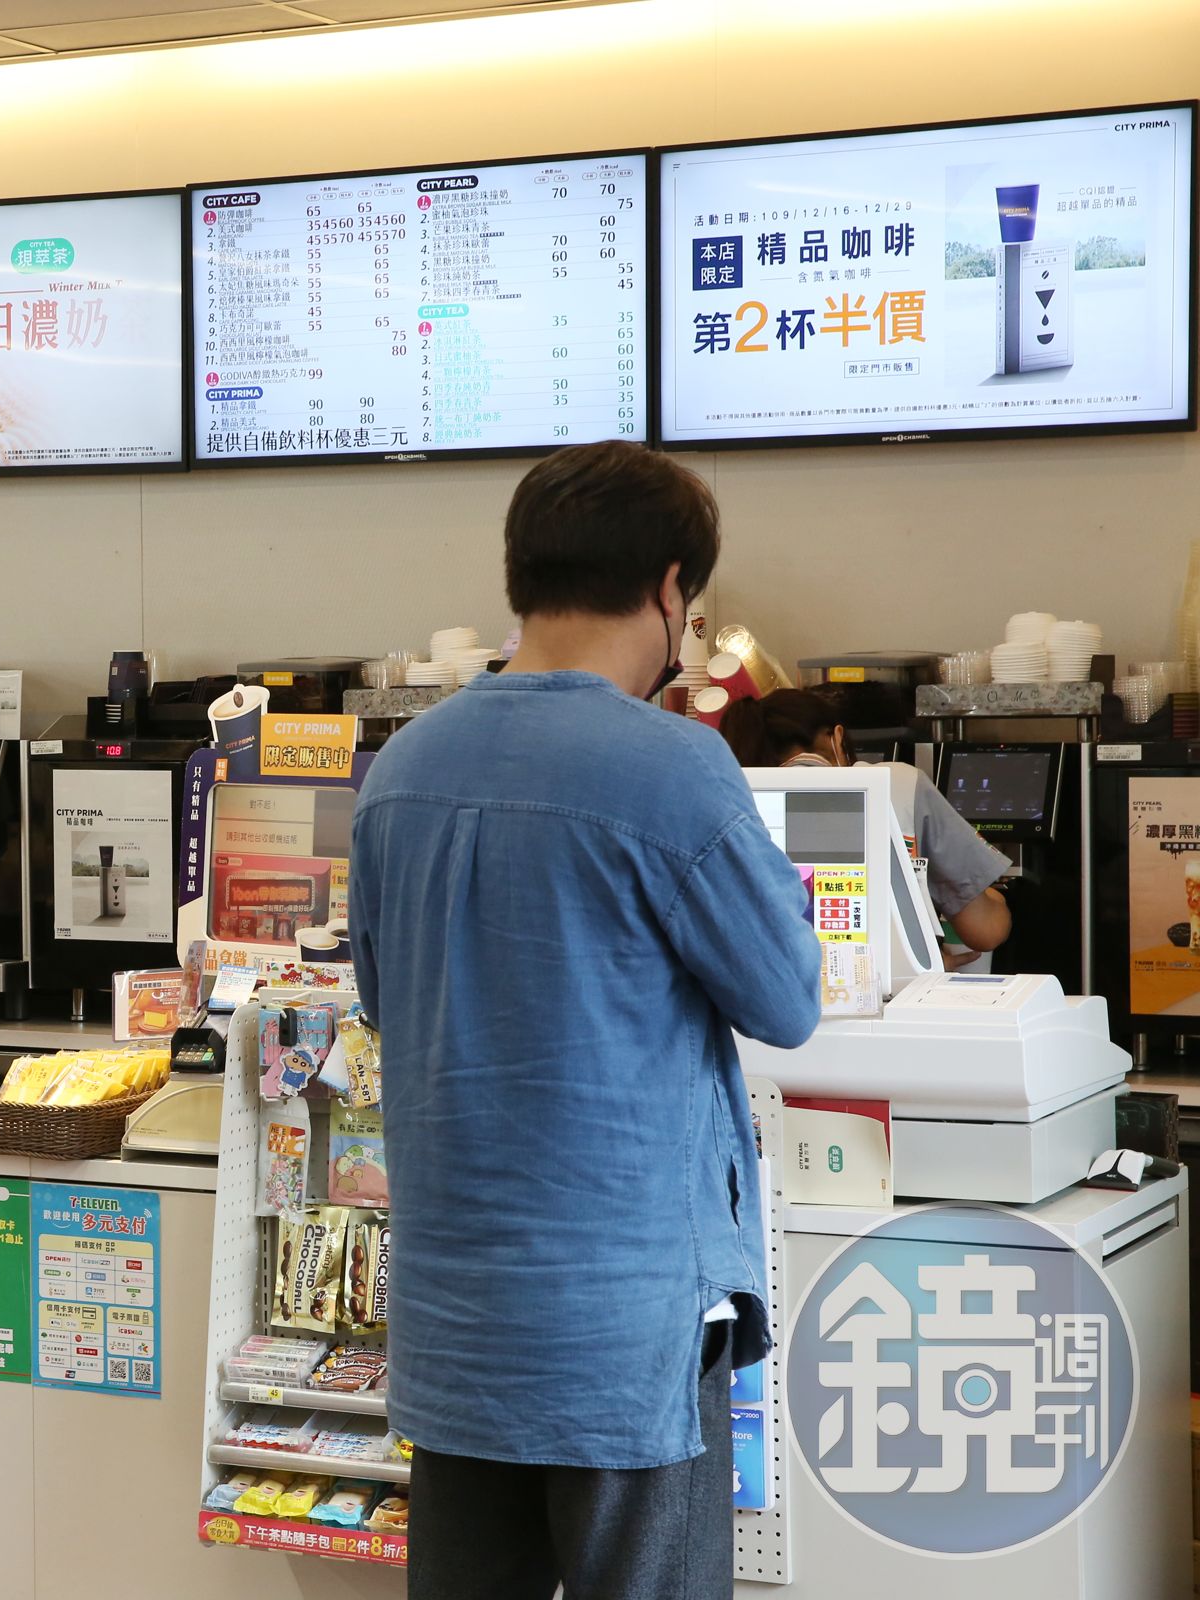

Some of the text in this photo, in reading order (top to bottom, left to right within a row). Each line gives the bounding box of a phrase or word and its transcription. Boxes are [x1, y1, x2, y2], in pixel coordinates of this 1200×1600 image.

[1115, 120, 1171, 132] CITY PRIMA
[421, 177, 474, 190] CITY PEARL
[552, 187, 567, 198] 70
[206, 195, 257, 207] CITY CAFE
[1057, 196, 1137, 212] 超越單品的精品
[358, 202, 372, 213] 65
[323, 219, 337, 230] 45
[374, 215, 389, 226] 45
[307, 235, 321, 246] 45
[358, 231, 372, 242] 45
[552, 235, 567, 246] 70
[757, 222, 916, 267] 精品咖啡
[374, 244, 389, 255] 65
[701, 242, 736, 263] 本店
[17, 247, 70, 267] 現萃茶
[307, 263, 321, 274] 55
[618, 263, 633, 274] 55
[701, 265, 736, 286] 限定
[798, 267, 873, 285] 含氮氣咖啡
[49, 281, 84, 293] Winter
[618, 278, 633, 289] 45
[307, 306, 322, 317] 45
[422, 307, 464, 316] CITY TEA
[308, 321, 322, 331] 55
[693, 290, 927, 355] 第2杯半價
[392, 330, 407, 341] 75
[392, 345, 407, 356] 80
[848, 362, 915, 376] 限定門市販售
[553, 379, 568, 389] 50
[209, 388, 260, 399] CITY PRIMA
[618, 392, 633, 402] 35
[220, 401, 257, 411] 精品拿鐵
[618, 407, 633, 418] 65
[220, 417, 257, 427] 精品美式
[553, 426, 568, 436] 50
[207, 427, 408, 453] 提供自備飲料杯優惠三元
[274, 722, 341, 735] CITY PRIMA
[226, 736, 255, 749] CITY PRIMA
[264, 745, 349, 769] 限定販售中
[189, 767, 202, 820] 只有精品
[56, 808, 103, 817] CITY PRIMA
[66, 818, 93, 826] 精品咖啡
[187, 837, 198, 892] 超越單品
[915, 859, 926, 867] 179
[816, 881, 864, 892] 1點抵1元
[853, 901, 861, 928] 一次完成
[355, 1057, 371, 1102] LAN-587
[43, 1210, 146, 1235] 歡迎使用 多元支付
[74, 1241, 103, 1251] 掃碼支付
[306, 1225, 327, 1288] ALMOND
[294, 1224, 315, 1313] CHOCOBALL
[374, 1228, 390, 1321] CHOCOBALL
[46, 1304, 81, 1315] 信用卡支付
[112, 1312, 140, 1322] 電子票證
[245, 1525, 330, 1549] 下午茶點隨手包
